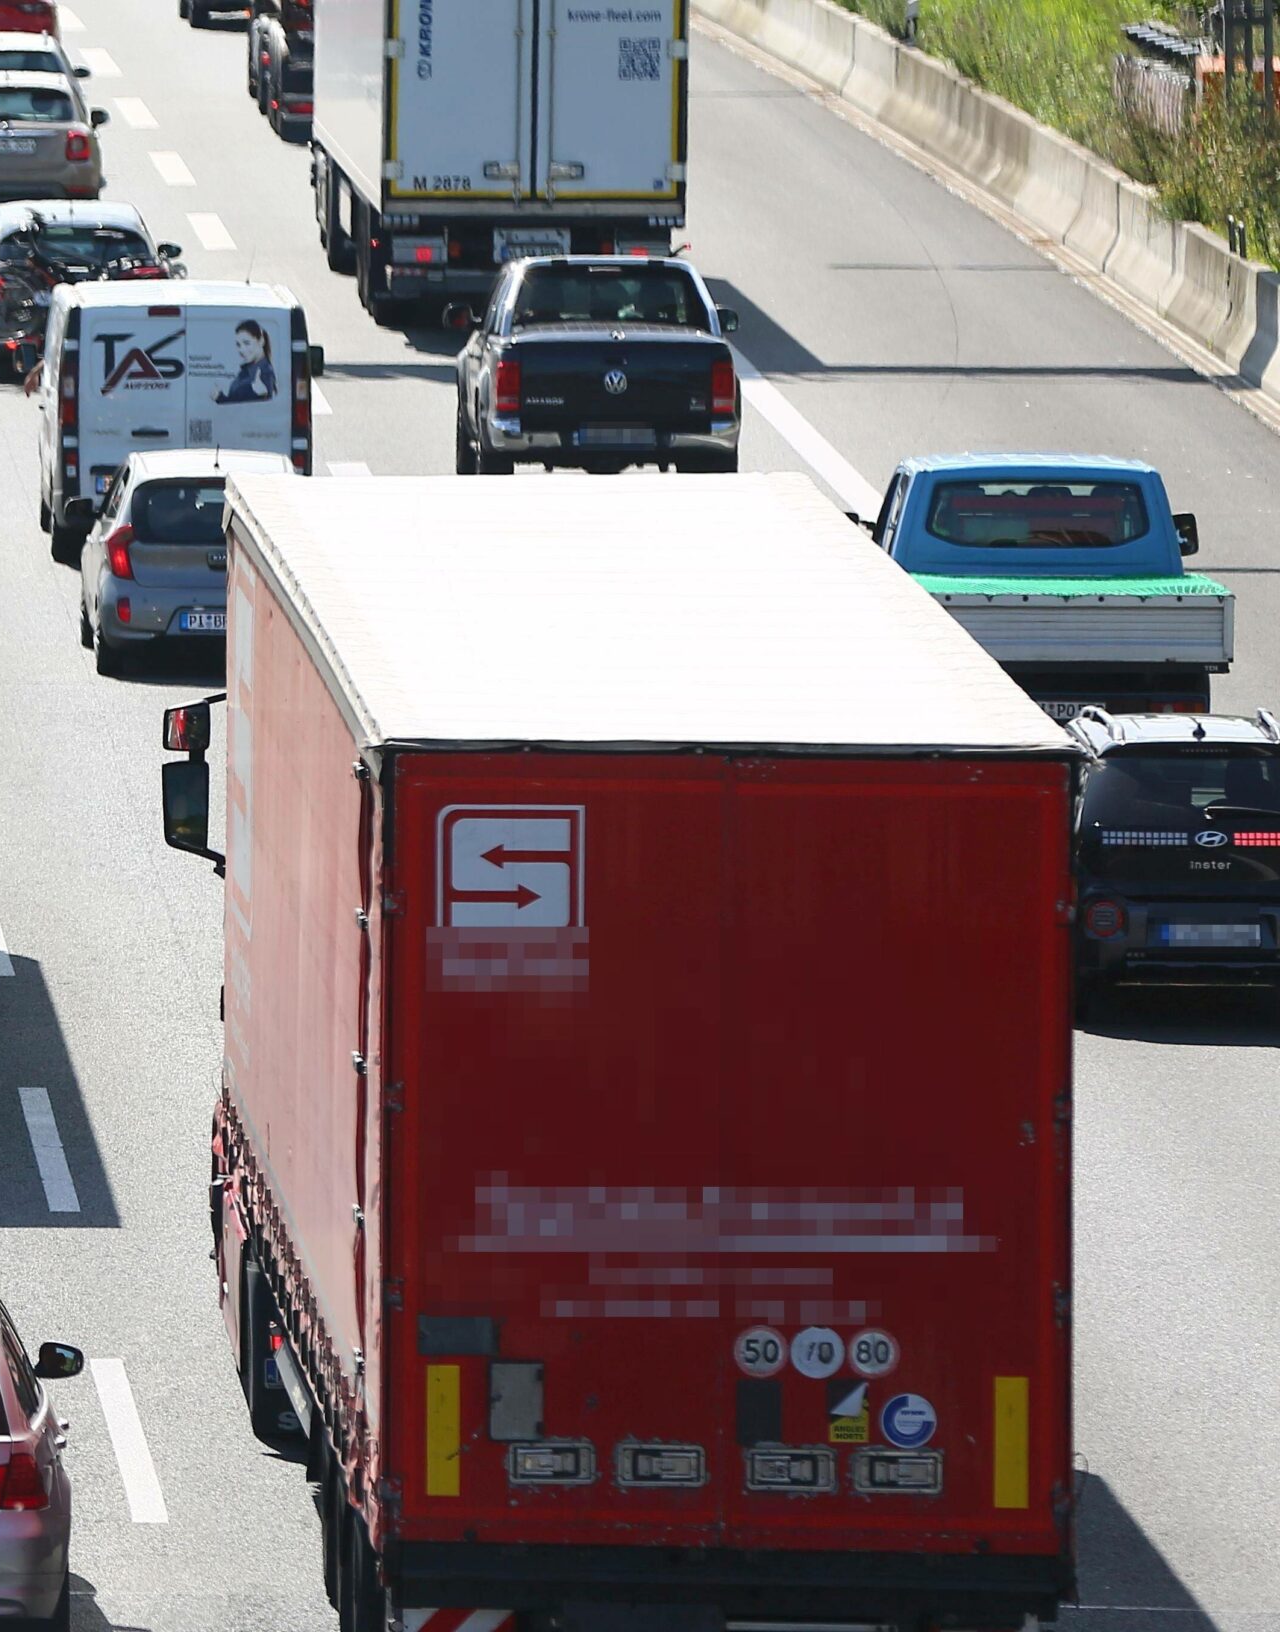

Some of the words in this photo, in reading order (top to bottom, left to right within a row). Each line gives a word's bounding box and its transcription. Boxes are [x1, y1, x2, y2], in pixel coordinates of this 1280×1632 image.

[567, 8, 661, 22] krone-fleet.com
[414, 177, 427, 191] M
[1189, 860, 1232, 870] inster
[744, 1339, 780, 1364] 50
[857, 1339, 890, 1365] 80
